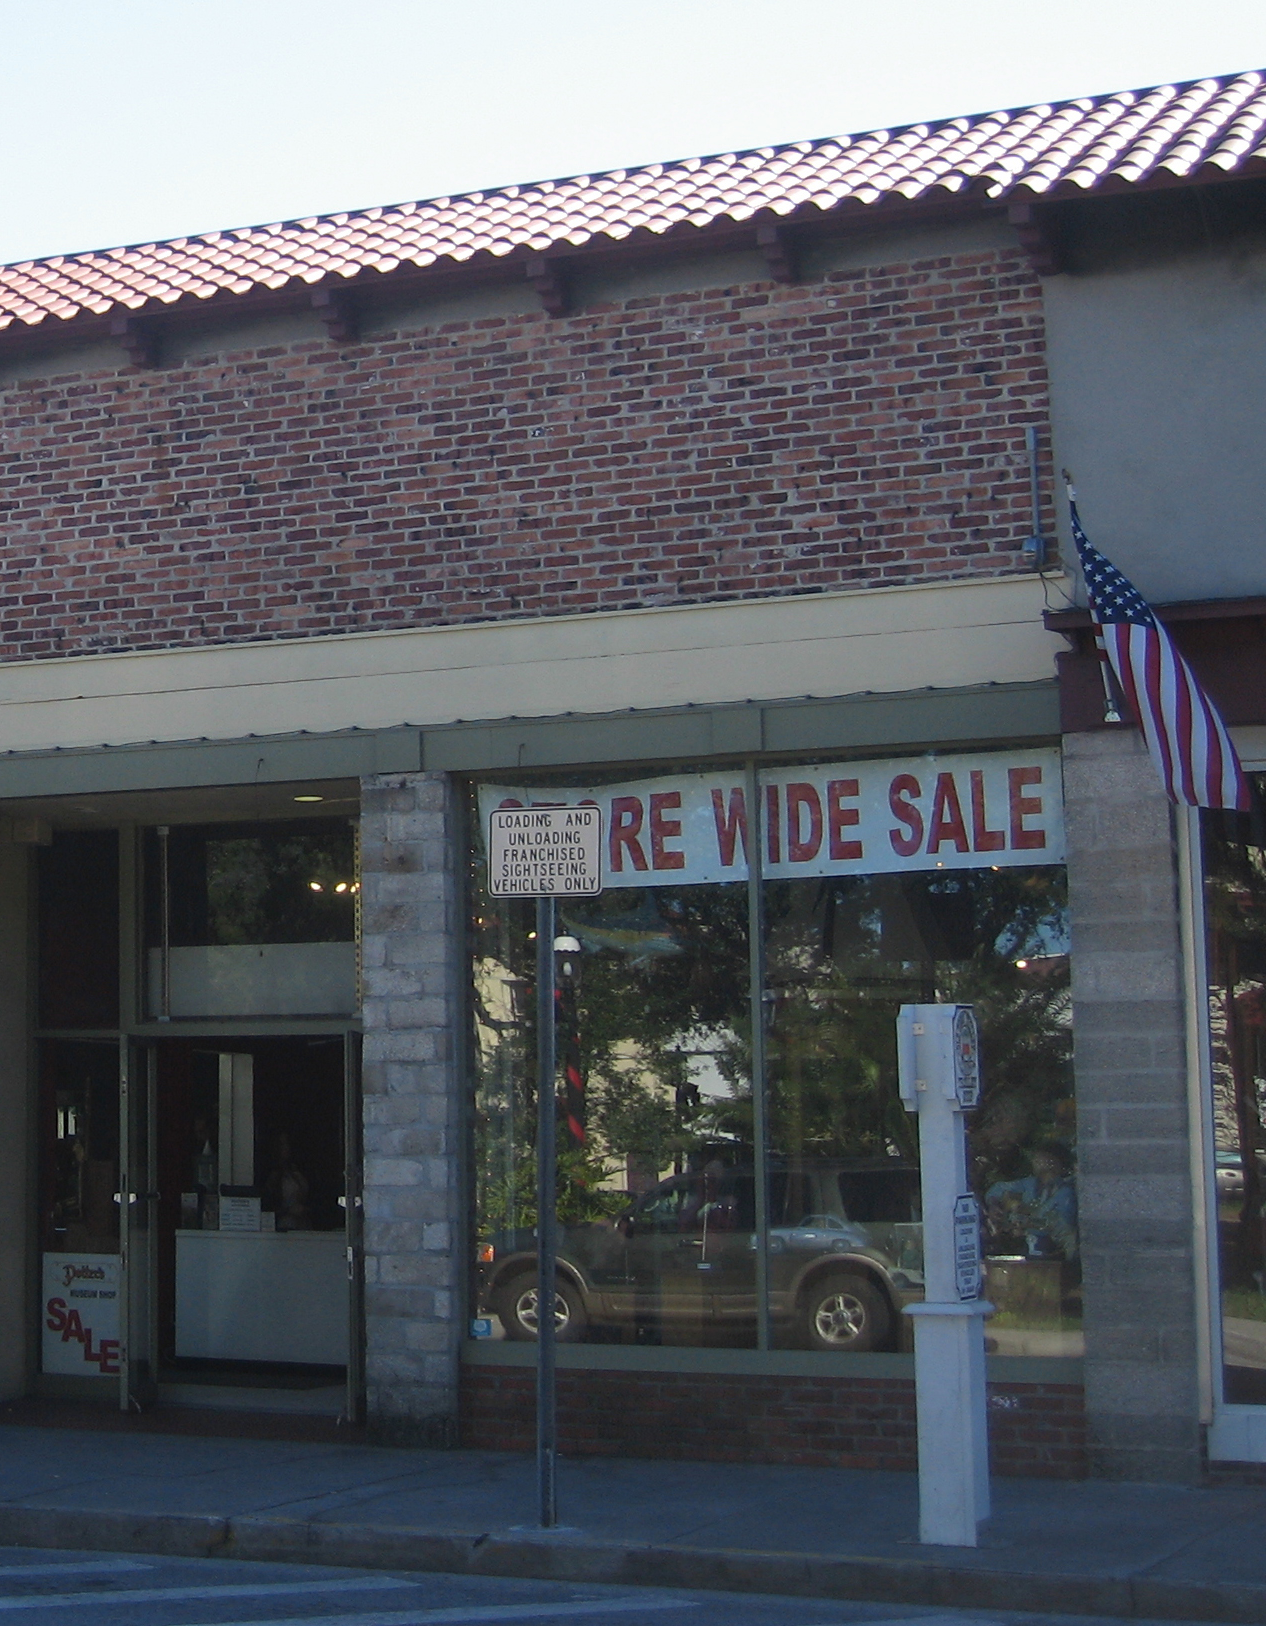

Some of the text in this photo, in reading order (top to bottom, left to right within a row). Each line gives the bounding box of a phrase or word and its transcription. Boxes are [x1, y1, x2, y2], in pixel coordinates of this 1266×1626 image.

[498, 812, 592, 829] LOADING AND
[711, 779, 863, 867] WIDE
[888, 766, 1046, 858] SALE
[508, 831, 581, 846] UNLOADING
[503, 847, 586, 862] FRANCHISED
[501, 862, 587, 877] SIGHTSEEING
[494, 877, 596, 892] VEHICLES ONLY
[46, 1297, 120, 1373] SALE
